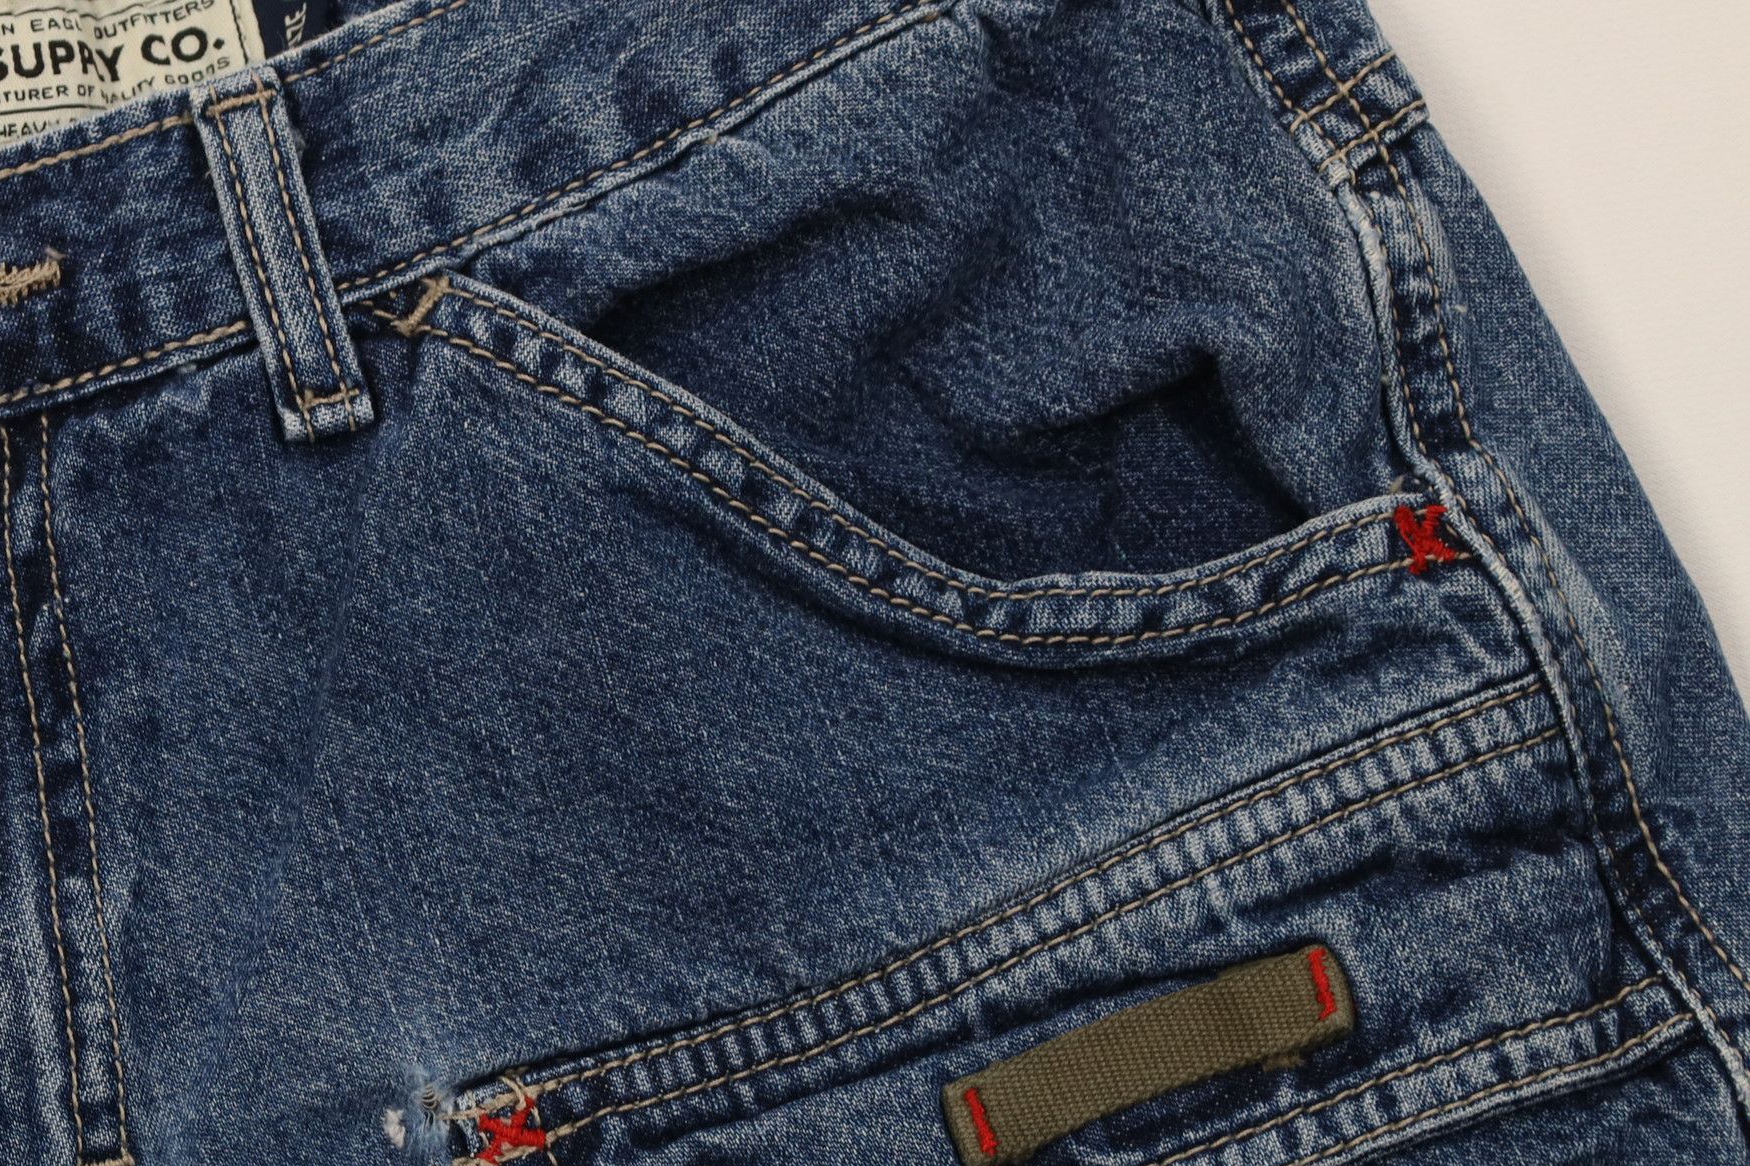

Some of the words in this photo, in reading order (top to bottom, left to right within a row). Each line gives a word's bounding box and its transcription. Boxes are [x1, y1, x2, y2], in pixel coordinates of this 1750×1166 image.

[30, 16, 82, 32] EAGL
[93, 0, 214, 39] OUTFITTERS
[140, 26, 225, 66] CO.
[77, 84, 95, 98] OF
